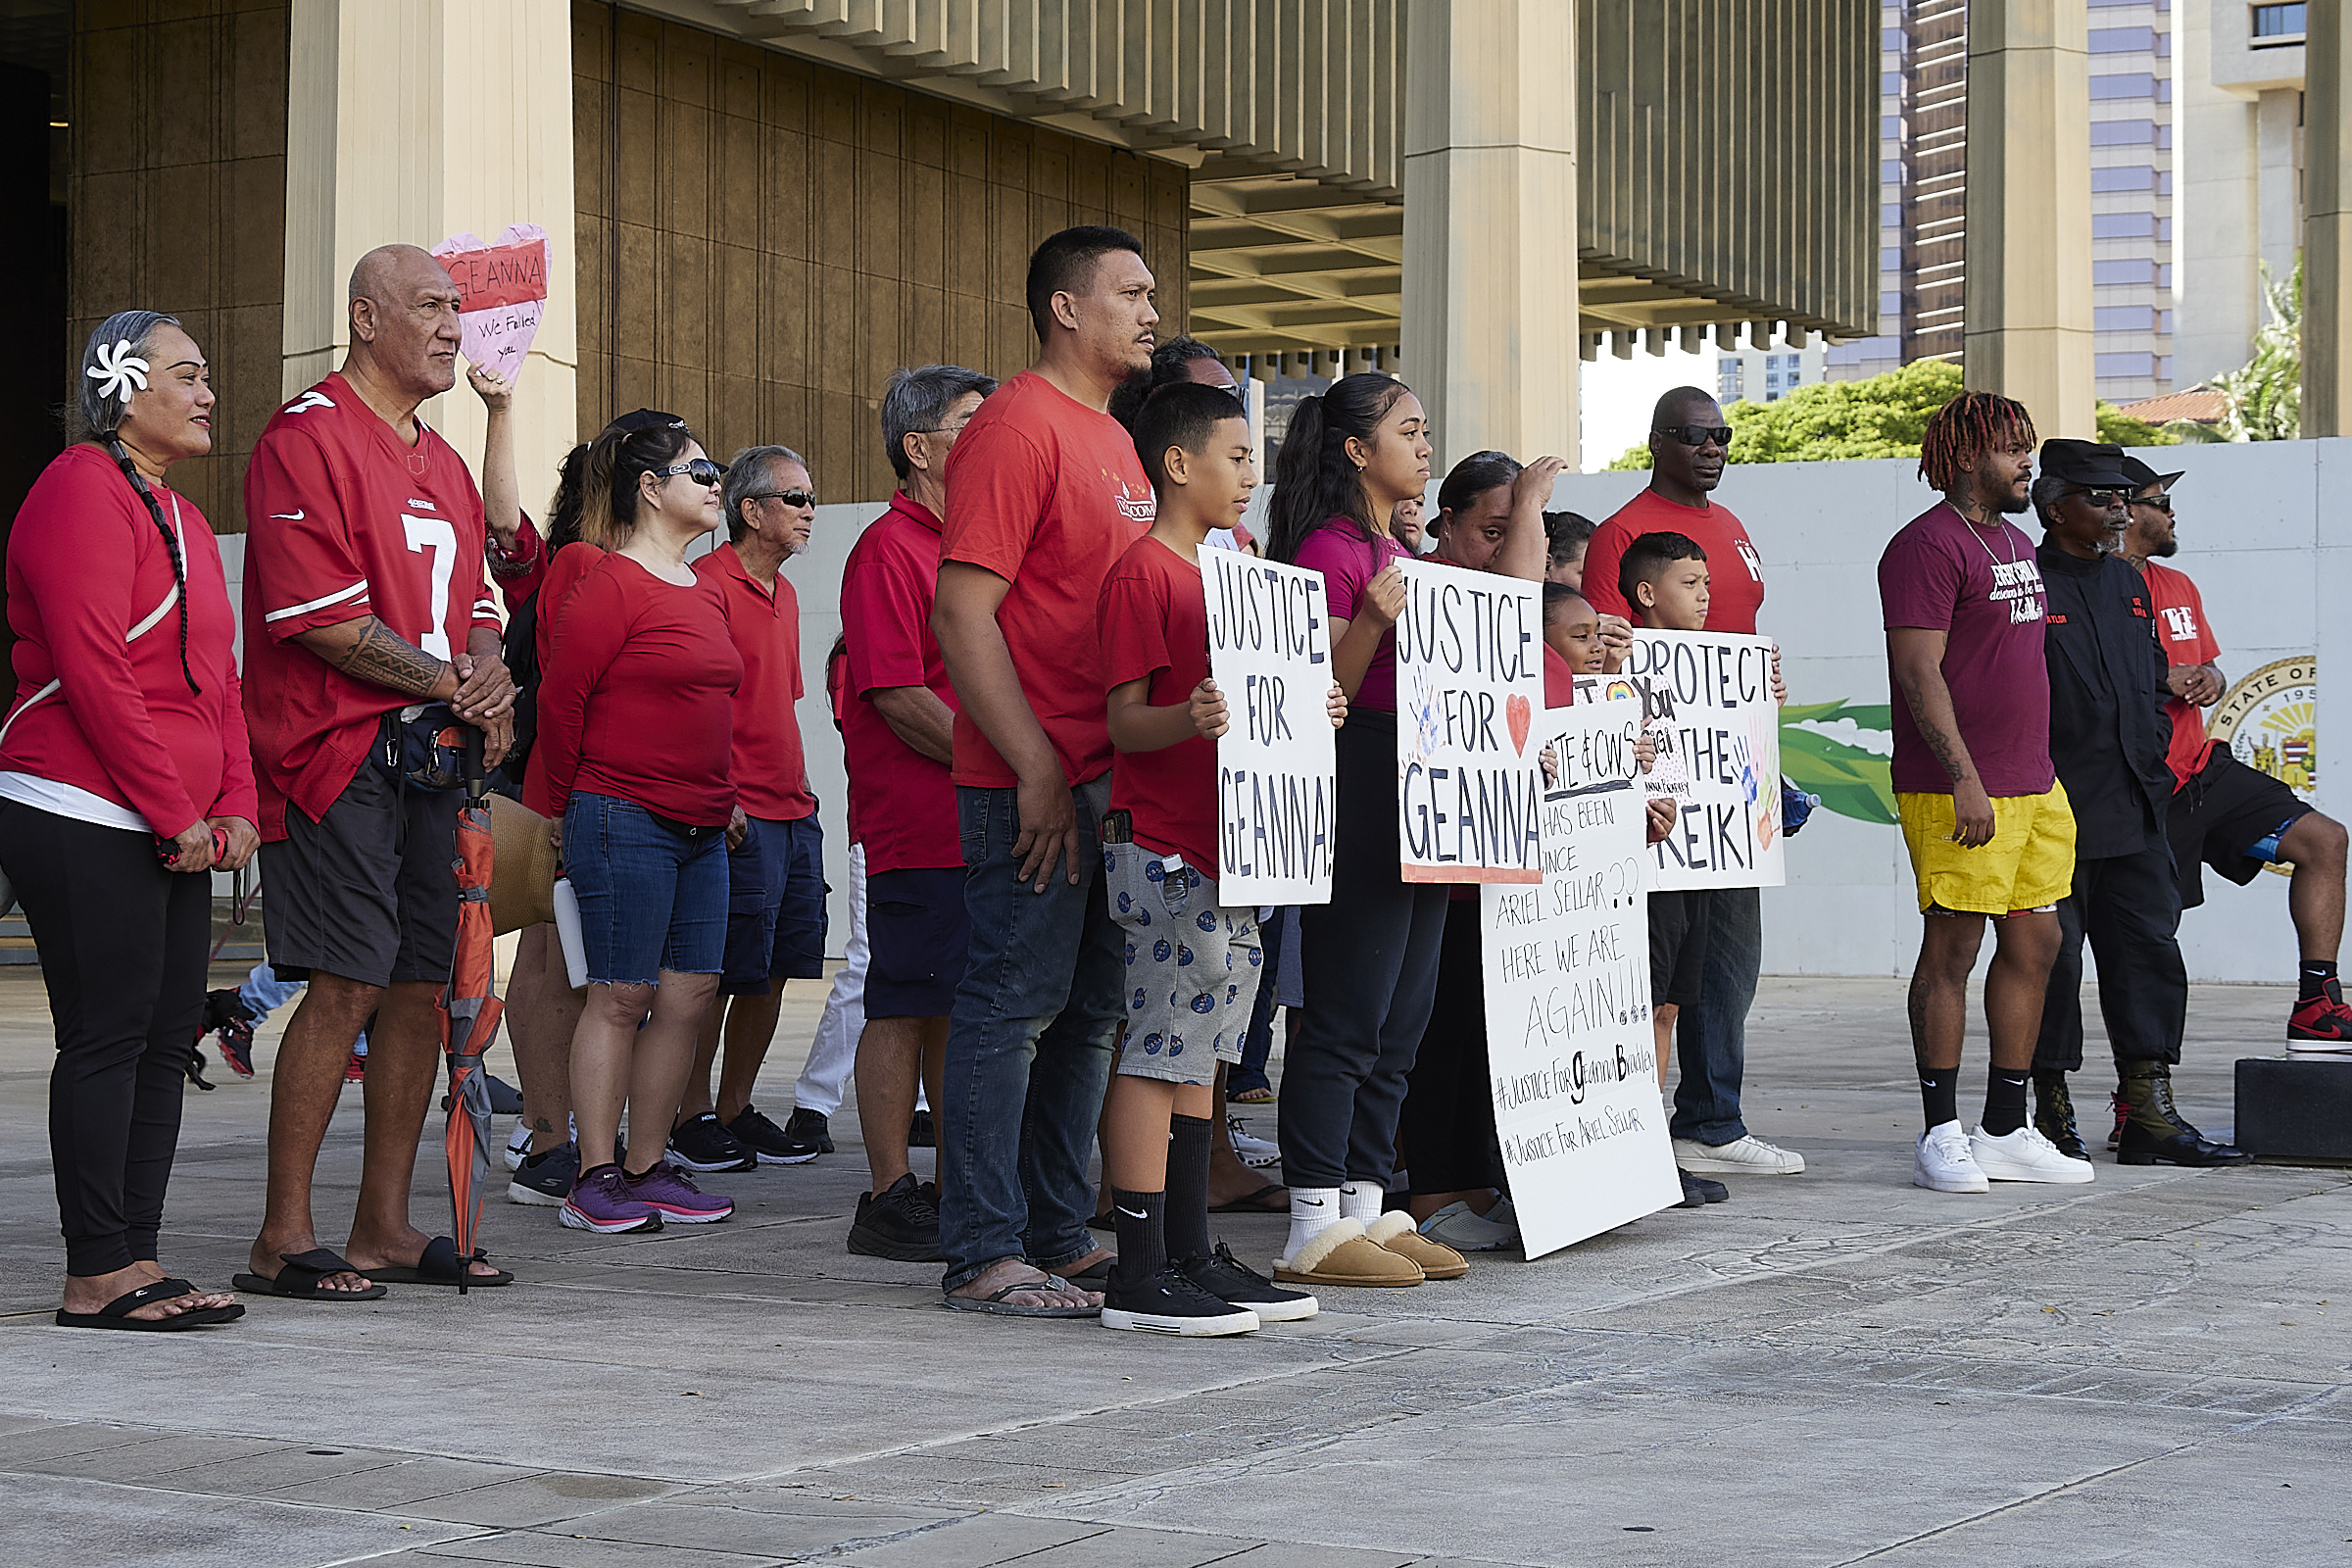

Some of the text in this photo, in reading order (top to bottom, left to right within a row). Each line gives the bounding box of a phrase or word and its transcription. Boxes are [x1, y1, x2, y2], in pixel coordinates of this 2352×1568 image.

[447, 255, 544, 302] GEANNA
[478, 310, 536, 338] We Failed
[400, 513, 458, 663] 7
[1212, 556, 1325, 664] JUSTICE
[1398, 575, 1537, 683] JUSTICE
[1247, 674, 1293, 747] FOR
[1444, 689, 1498, 753] FOR
[2221, 666, 2317, 726] STATE OF
[1593, 720, 1639, 780] CWS
[1221, 765, 1334, 886] GEANNA!
[1403, 761, 1542, 870] GEANNA
[1543, 797, 1615, 839] HAS BEEN
[1542, 845, 1580, 875] INCE
[1495, 888, 1547, 930] ARIEL
[1501, 923, 1626, 984] HERE WE ARE
